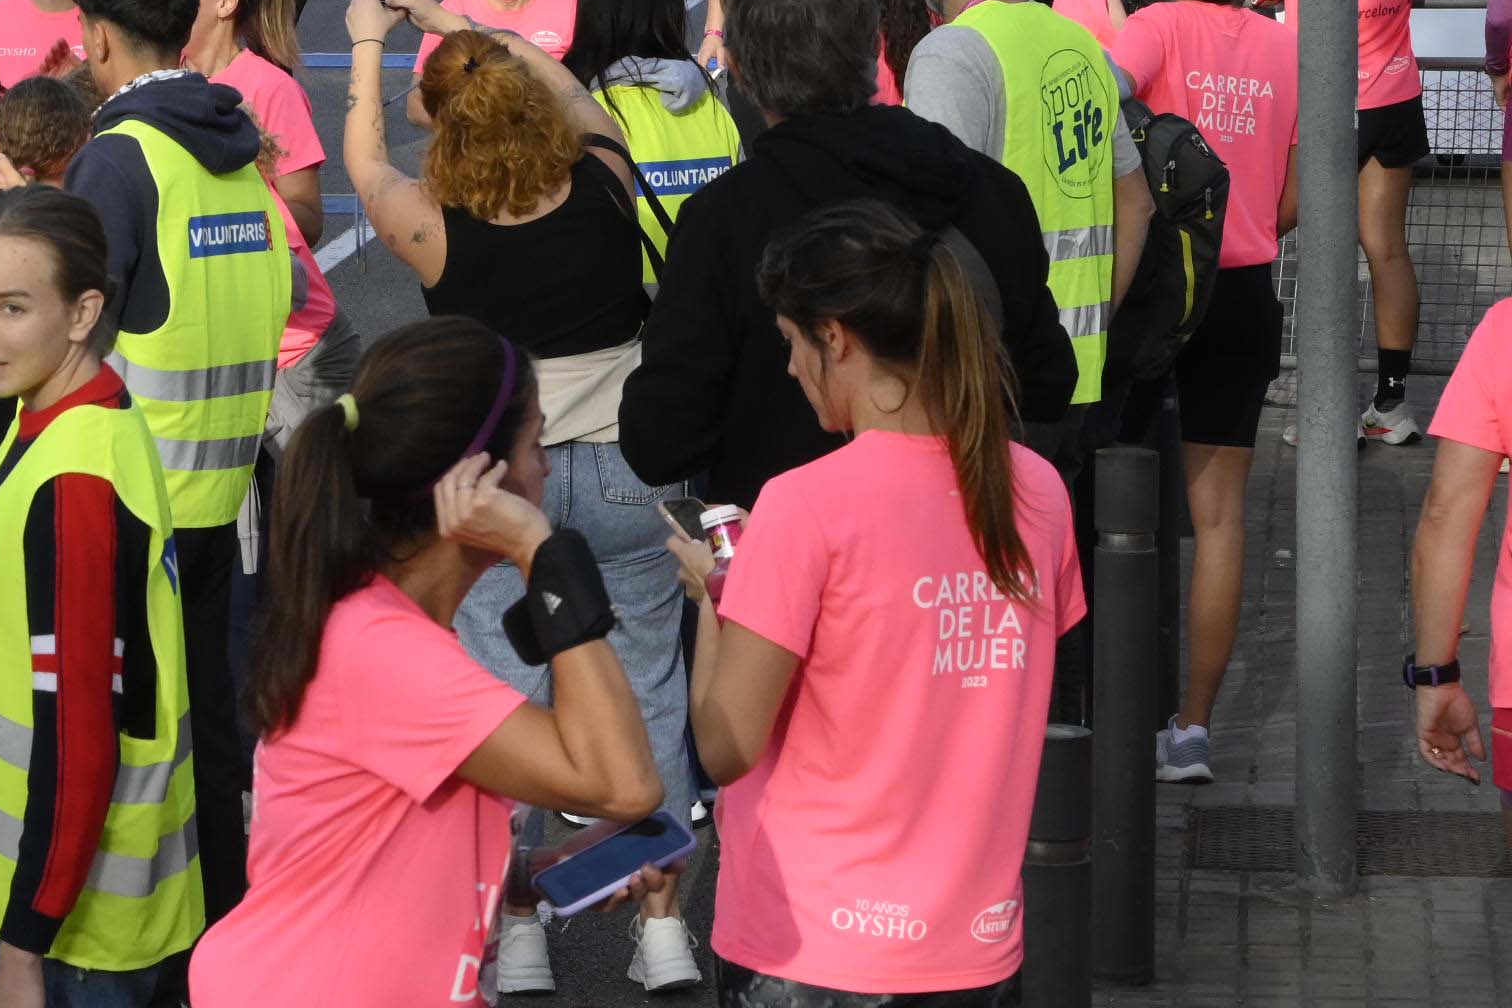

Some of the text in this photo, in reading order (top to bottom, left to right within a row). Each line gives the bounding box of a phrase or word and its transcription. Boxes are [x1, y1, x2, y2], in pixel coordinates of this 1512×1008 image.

[1186, 71, 1273, 99] CARRERA
[1202, 92, 1255, 115] DE LA
[1195, 110, 1256, 135] MUJER
[1053, 99, 1103, 176] Life
[190, 222, 266, 247] VOLUNTARIS
[939, 603, 1023, 640] DE LA
[932, 637, 1026, 677] MUJER
[961, 676, 988, 689] 2023
[871, 899, 910, 918] AÑOS
[831, 907, 927, 941] OYSHO
